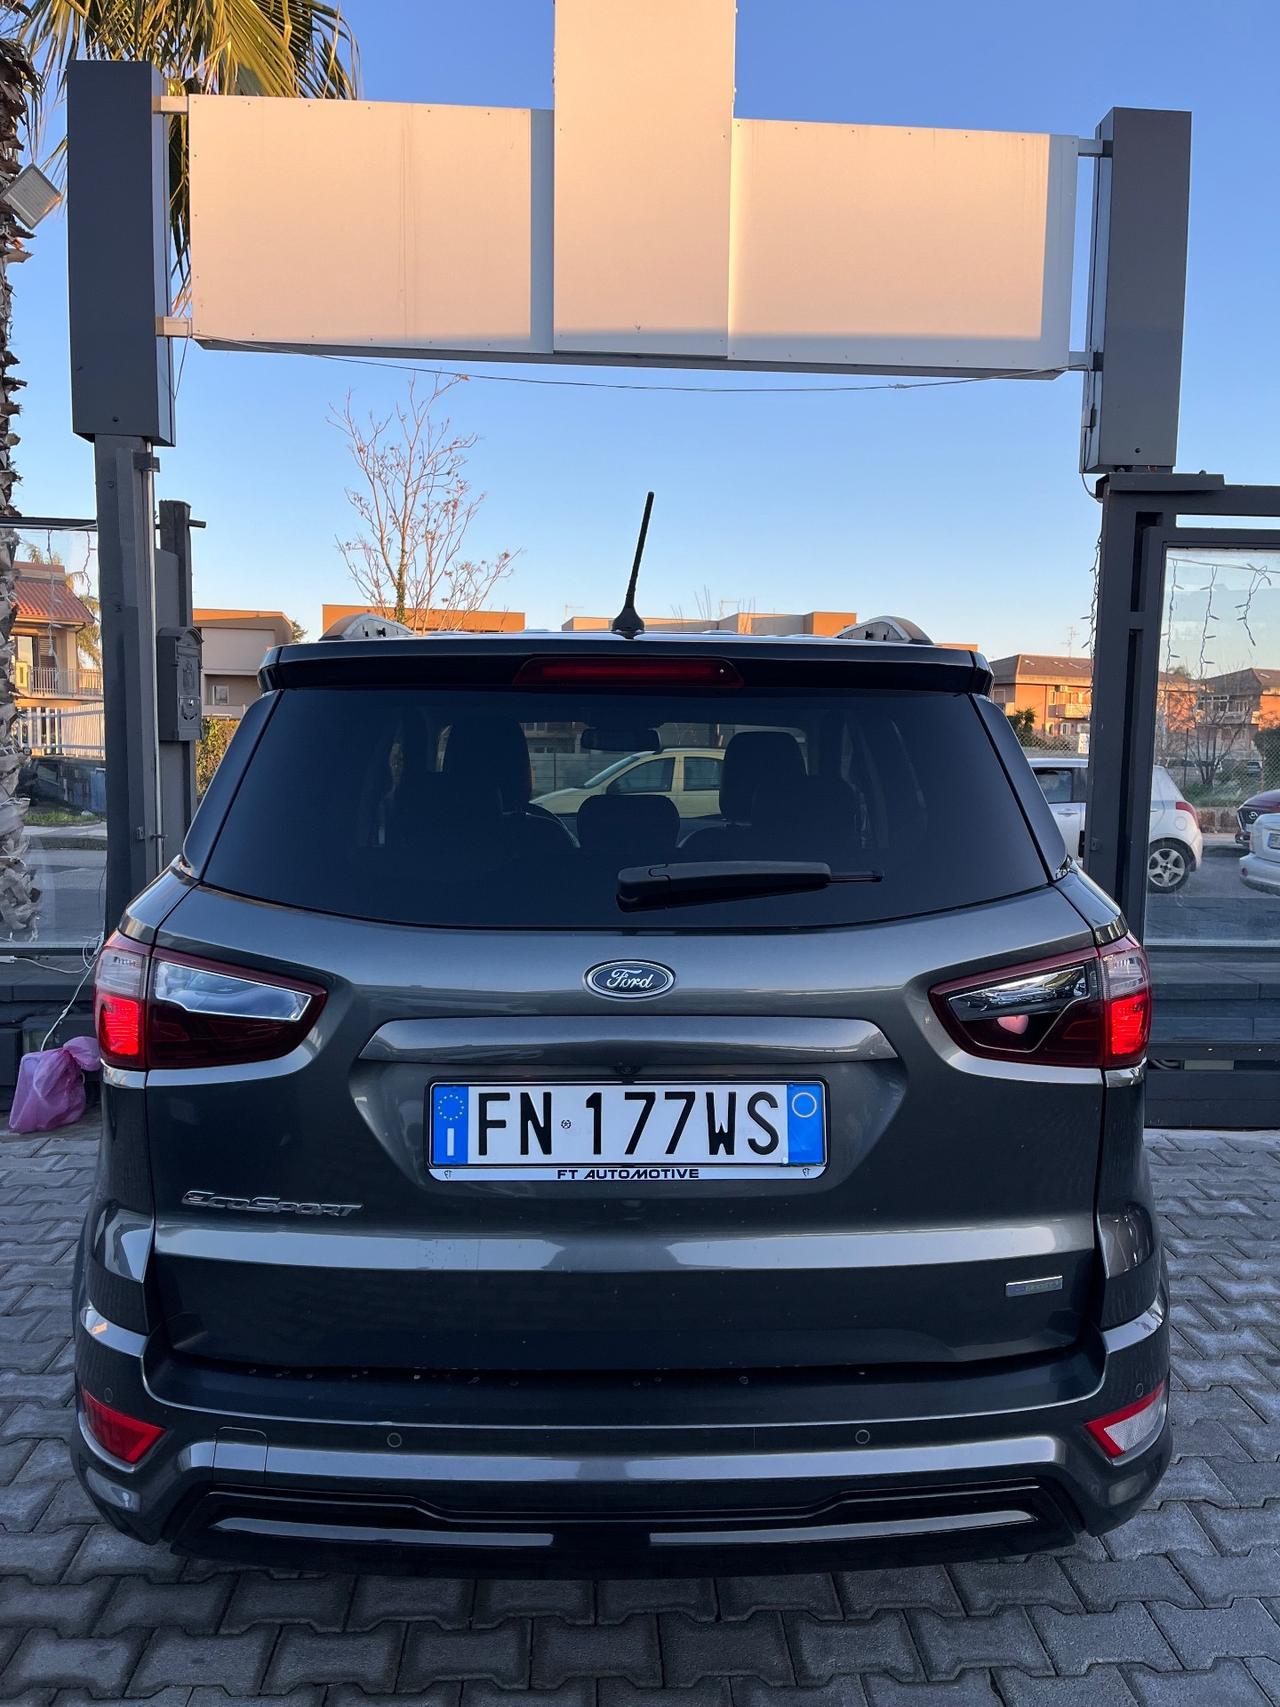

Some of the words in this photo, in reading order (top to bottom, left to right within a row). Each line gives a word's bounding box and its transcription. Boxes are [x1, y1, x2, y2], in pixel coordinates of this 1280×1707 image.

[606, 968, 654, 989] Ford
[477, 1092, 552, 1156] FN
[585, 1091, 780, 1155] 177WS
[557, 1169, 579, 1180] FT
[584, 1168, 700, 1180] AUTOMOTIVE
